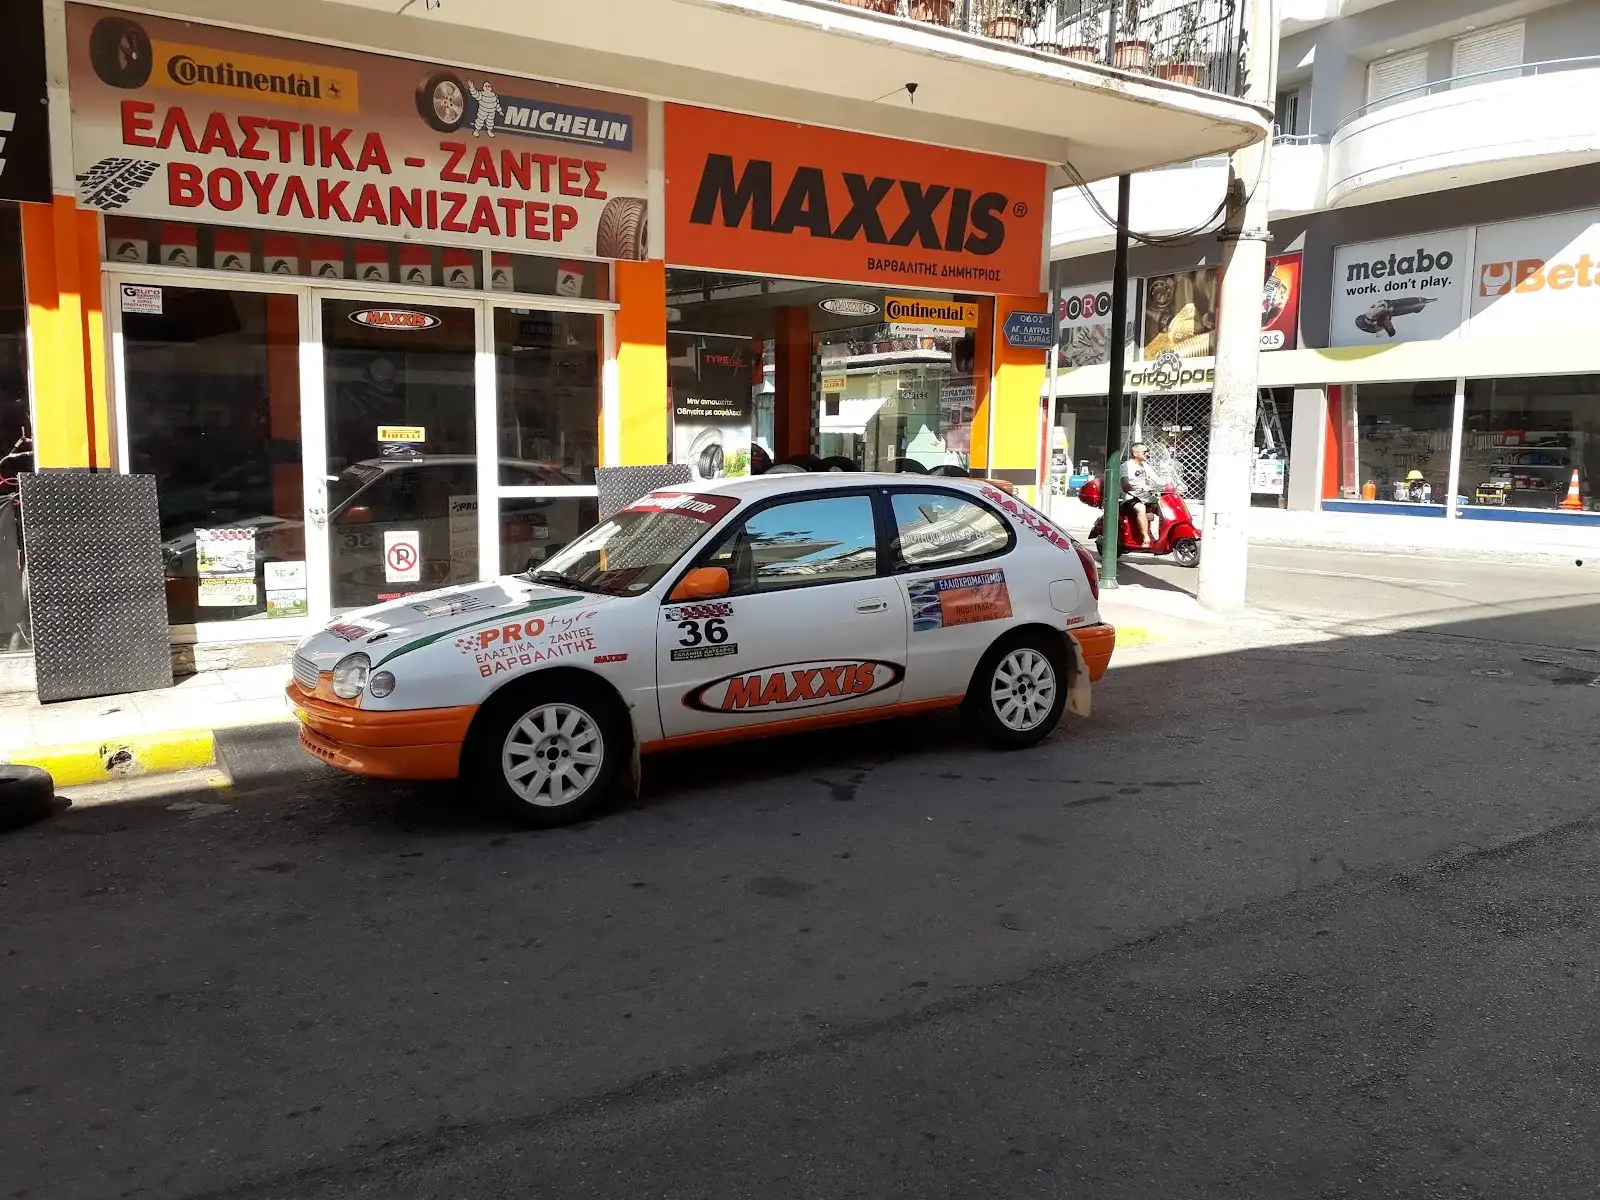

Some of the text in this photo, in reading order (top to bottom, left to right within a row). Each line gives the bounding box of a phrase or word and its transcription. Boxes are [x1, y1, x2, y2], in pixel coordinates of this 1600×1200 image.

[167, 55, 322, 99] Continental
[504, 106, 628, 142] MICHELIN
[121, 99, 392, 175] ΕΛΑΣΤΙΚΑ
[440, 141, 608, 199] ΖΑΝΤΕΣ
[167, 161, 579, 242] ΒΟΥΛΚΑΝΙΖΑΤΕΡ
[689, 152, 1010, 256] MAXXIS
[941, 263, 1002, 283] ΔΗΜΗΤΡΙΟΣ
[1346, 248, 1454, 282] metabo
[1346, 275, 1452, 296] work. don't play.
[366, 311, 426, 328] MAXXIS
[829, 301, 871, 314] MAXXIS
[886, 300, 964, 321] Continental
[1020, 315, 1044, 323] ΟΔΟΣ
[1023, 326, 1051, 335] ΛΑΥΡΑΣ
[382, 429, 421, 439] PIRELLI
[979, 486, 1071, 552] MAXXIS
[475, 641, 535, 664] ΕΛΑΣΤΙΚΑ
[549, 627, 593, 645] ΖΑΝΤΕΣ
[480, 618, 545, 650] PRO
[678, 618, 728, 647] 36
[721, 662, 878, 711] MAXXIS
